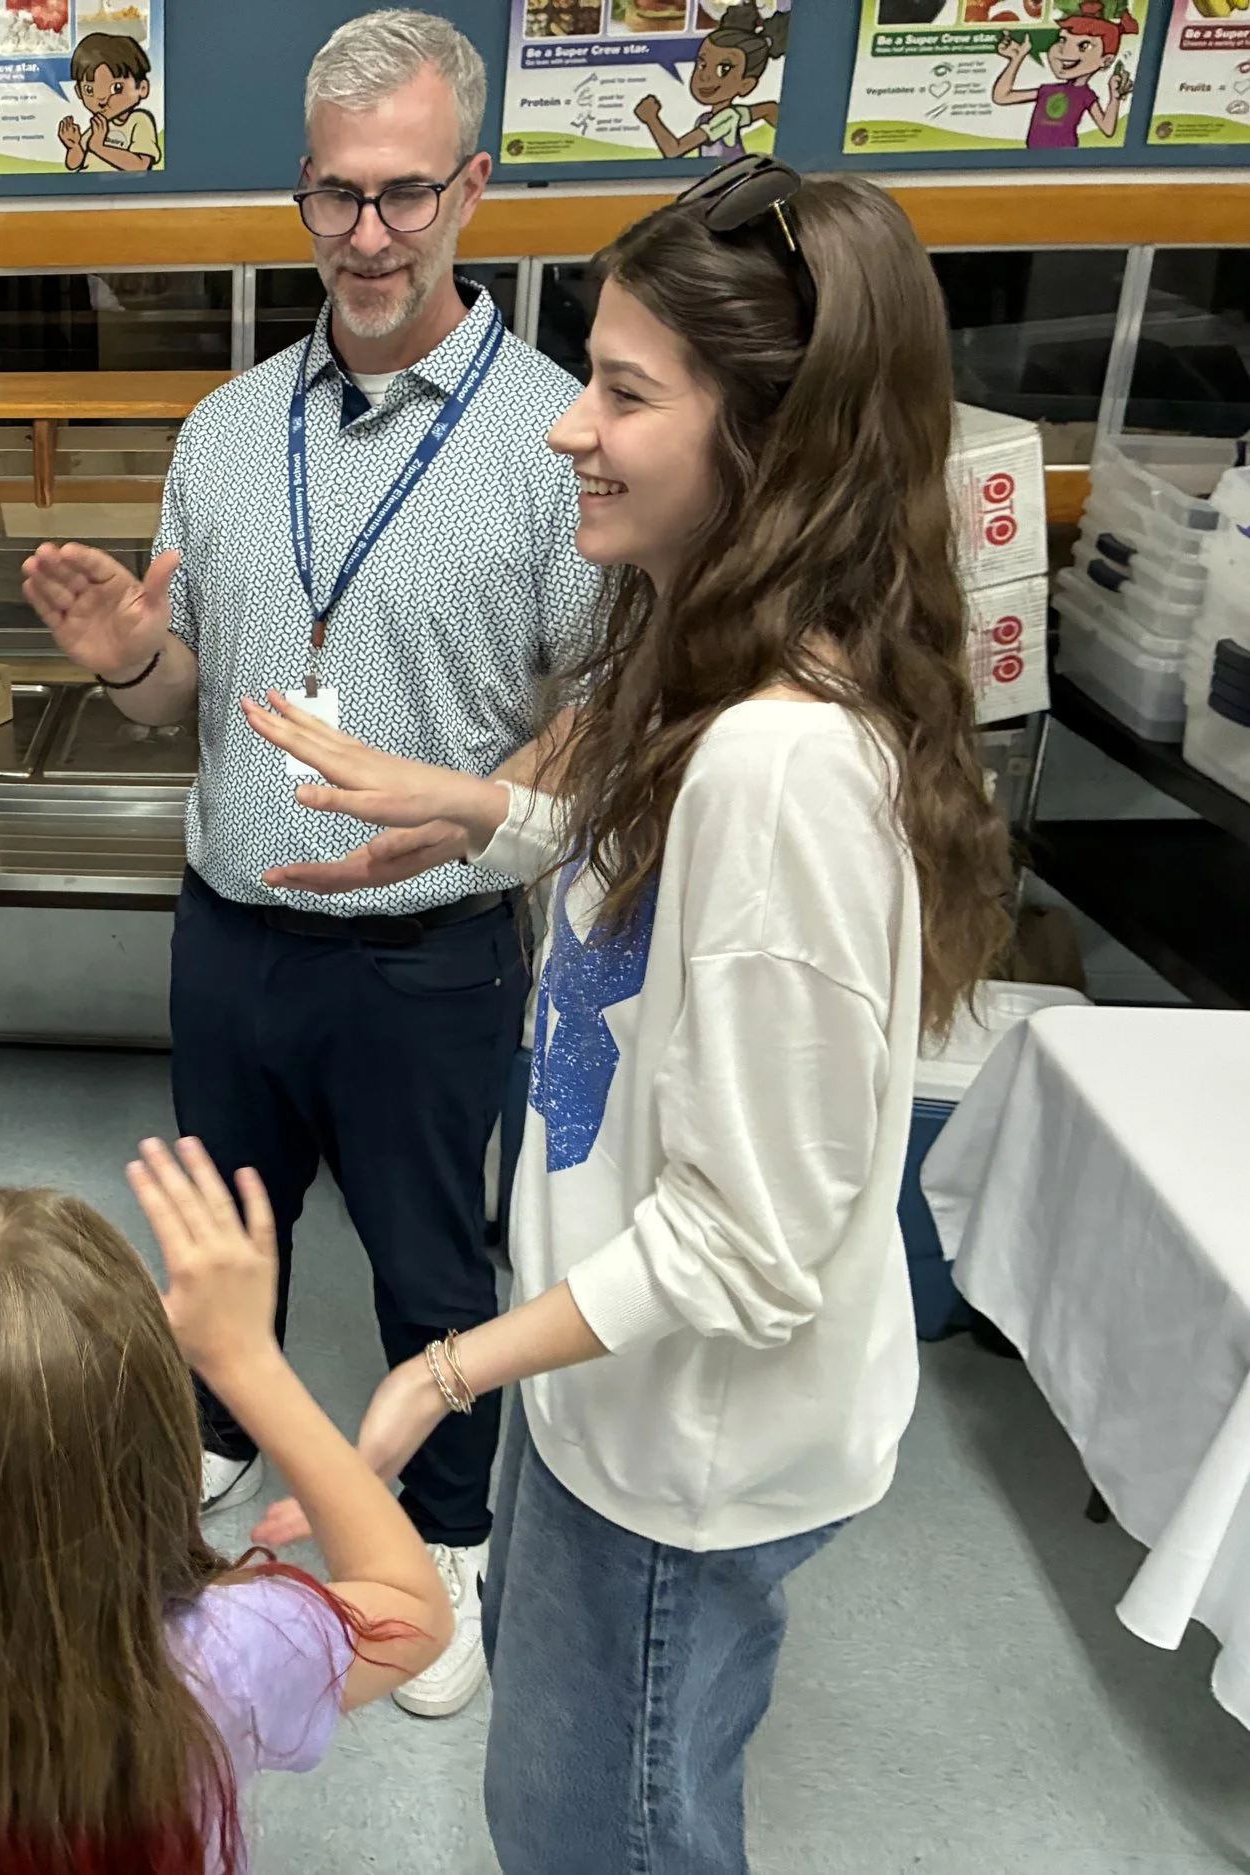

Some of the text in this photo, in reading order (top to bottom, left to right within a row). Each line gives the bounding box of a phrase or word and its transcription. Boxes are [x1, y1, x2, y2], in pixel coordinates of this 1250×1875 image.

[1185, 29, 1201, 38] Be
[1214, 28, 1249, 39] Super
[526, 48, 542, 58] Be
[544, 49, 552, 57] a
[555, 47, 589, 57] Super
[591, 45, 621, 55] Crew
[16, 62, 40, 72] star.
[1179, 82, 1211, 92] Fruits
[520, 97, 561, 107] Protein
[456, 369, 480, 403] School
[292, 453, 308, 571] Zippel Elementary School
[343, 458, 424, 574] Zippel Elementary School
